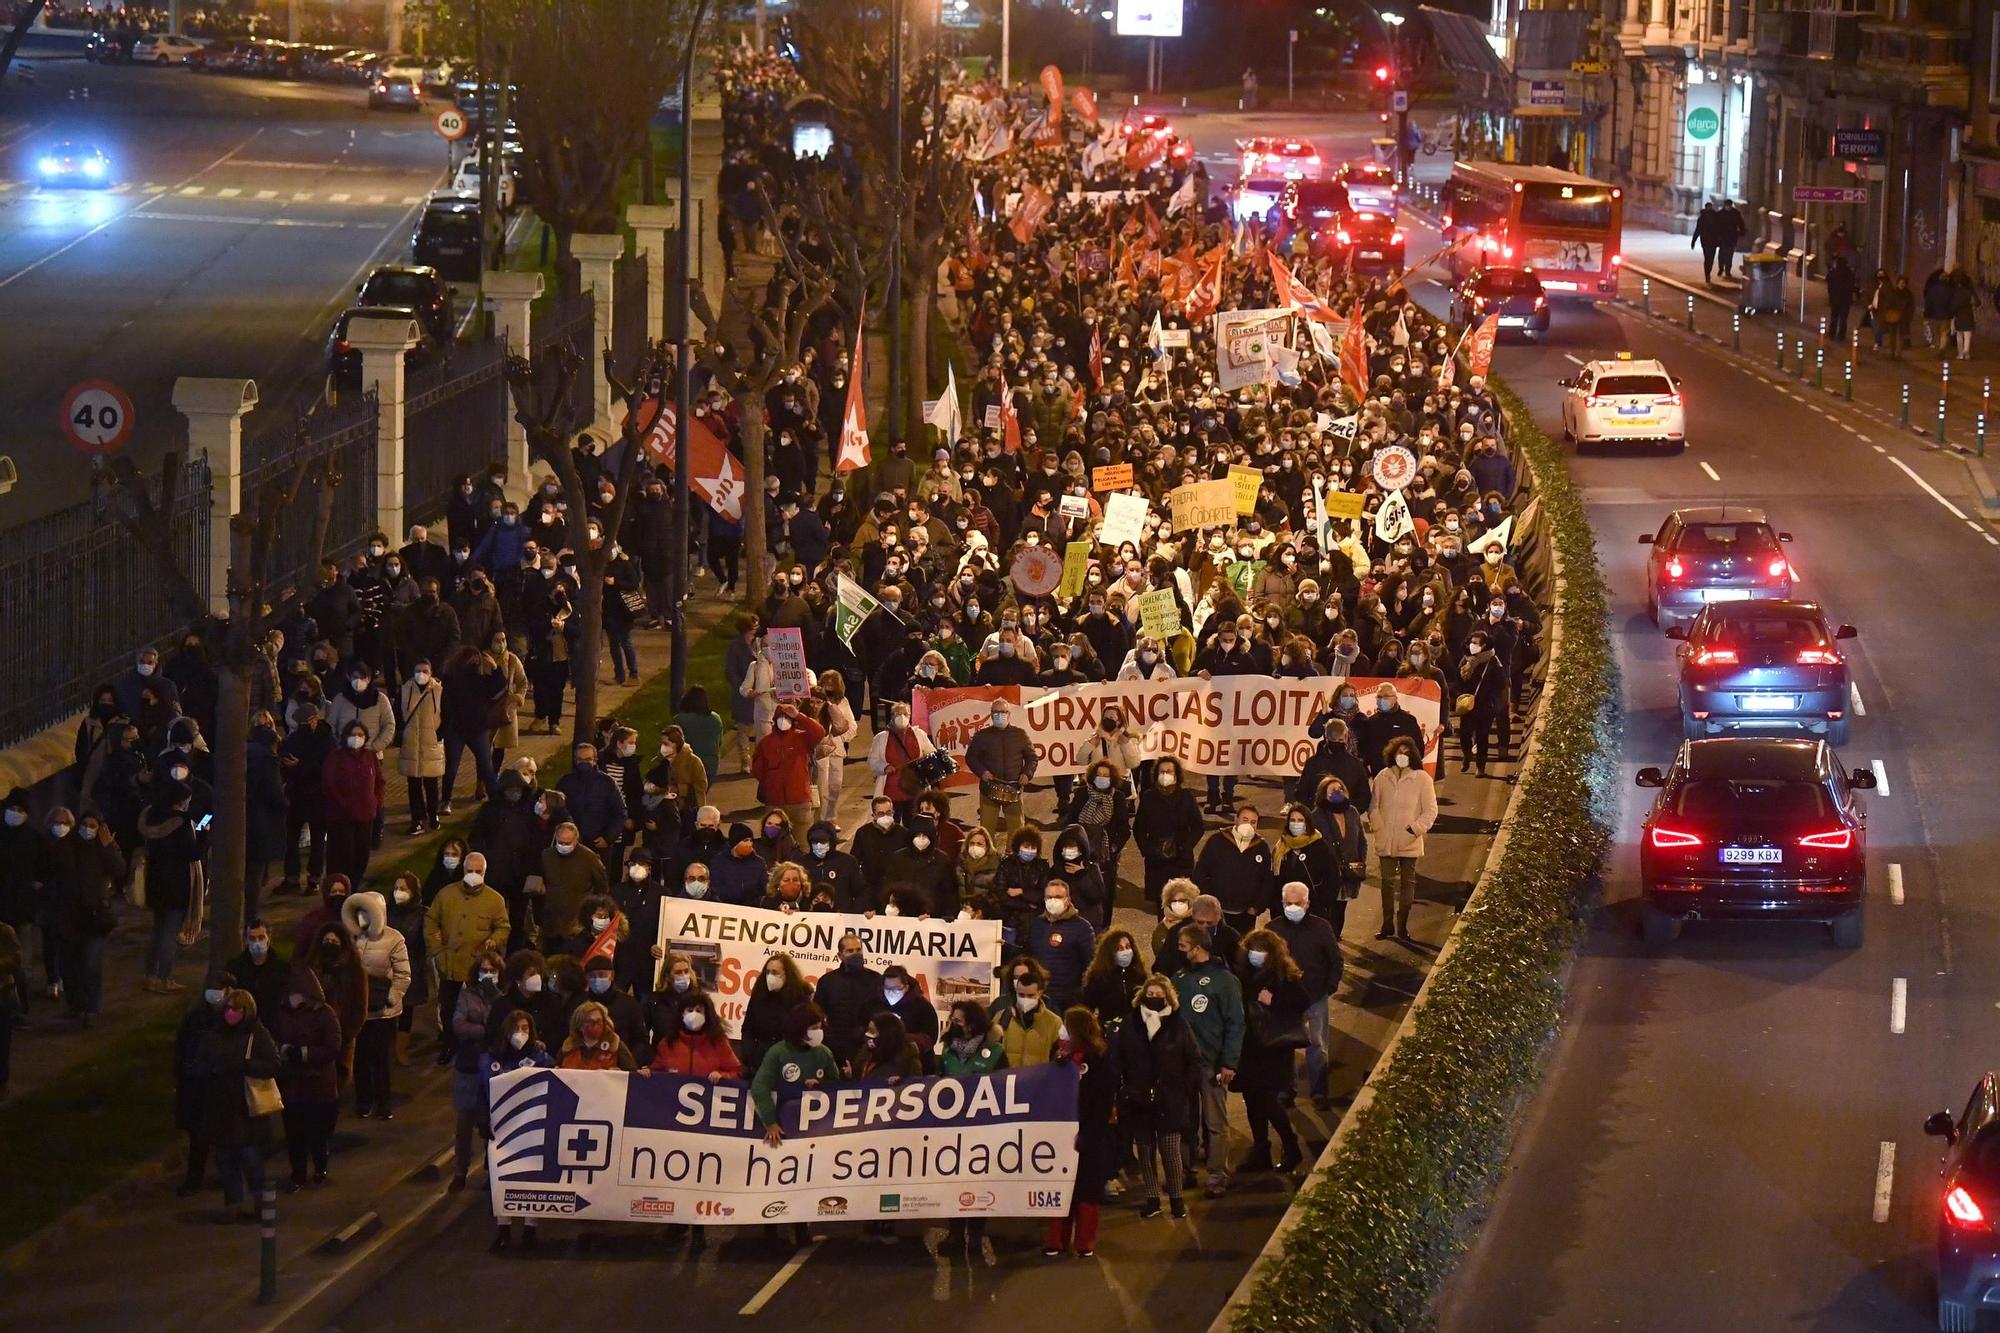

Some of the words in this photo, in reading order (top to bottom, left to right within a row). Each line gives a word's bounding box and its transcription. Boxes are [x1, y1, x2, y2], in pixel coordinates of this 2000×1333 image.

[441, 118, 459, 130] 40
[74, 404, 118, 430] 40
[1033, 741, 1091, 767] POL
[1197, 738, 1230, 767] DE
[1726, 850, 1754, 861] 9299
[1758, 850, 1780, 861] KBX
[679, 913, 834, 951] ATENCIÓN
[788, 950, 831, 963] Sanitaria
[875, 957, 893, 966] Cee
[799, 1074, 1030, 1131] PERSOAL
[631, 1146, 722, 1185] non
[746, 1143, 816, 1187] hai
[832, 1128, 1069, 1181] sanidade.
[505, 1191, 536, 1201] COMISIÓN
[538, 1193, 547, 1201] DE
[548, 1194, 575, 1202] CENTRO
[1028, 1191, 1062, 1207] USAE
[504, 1202, 574, 1213] CHUAC
